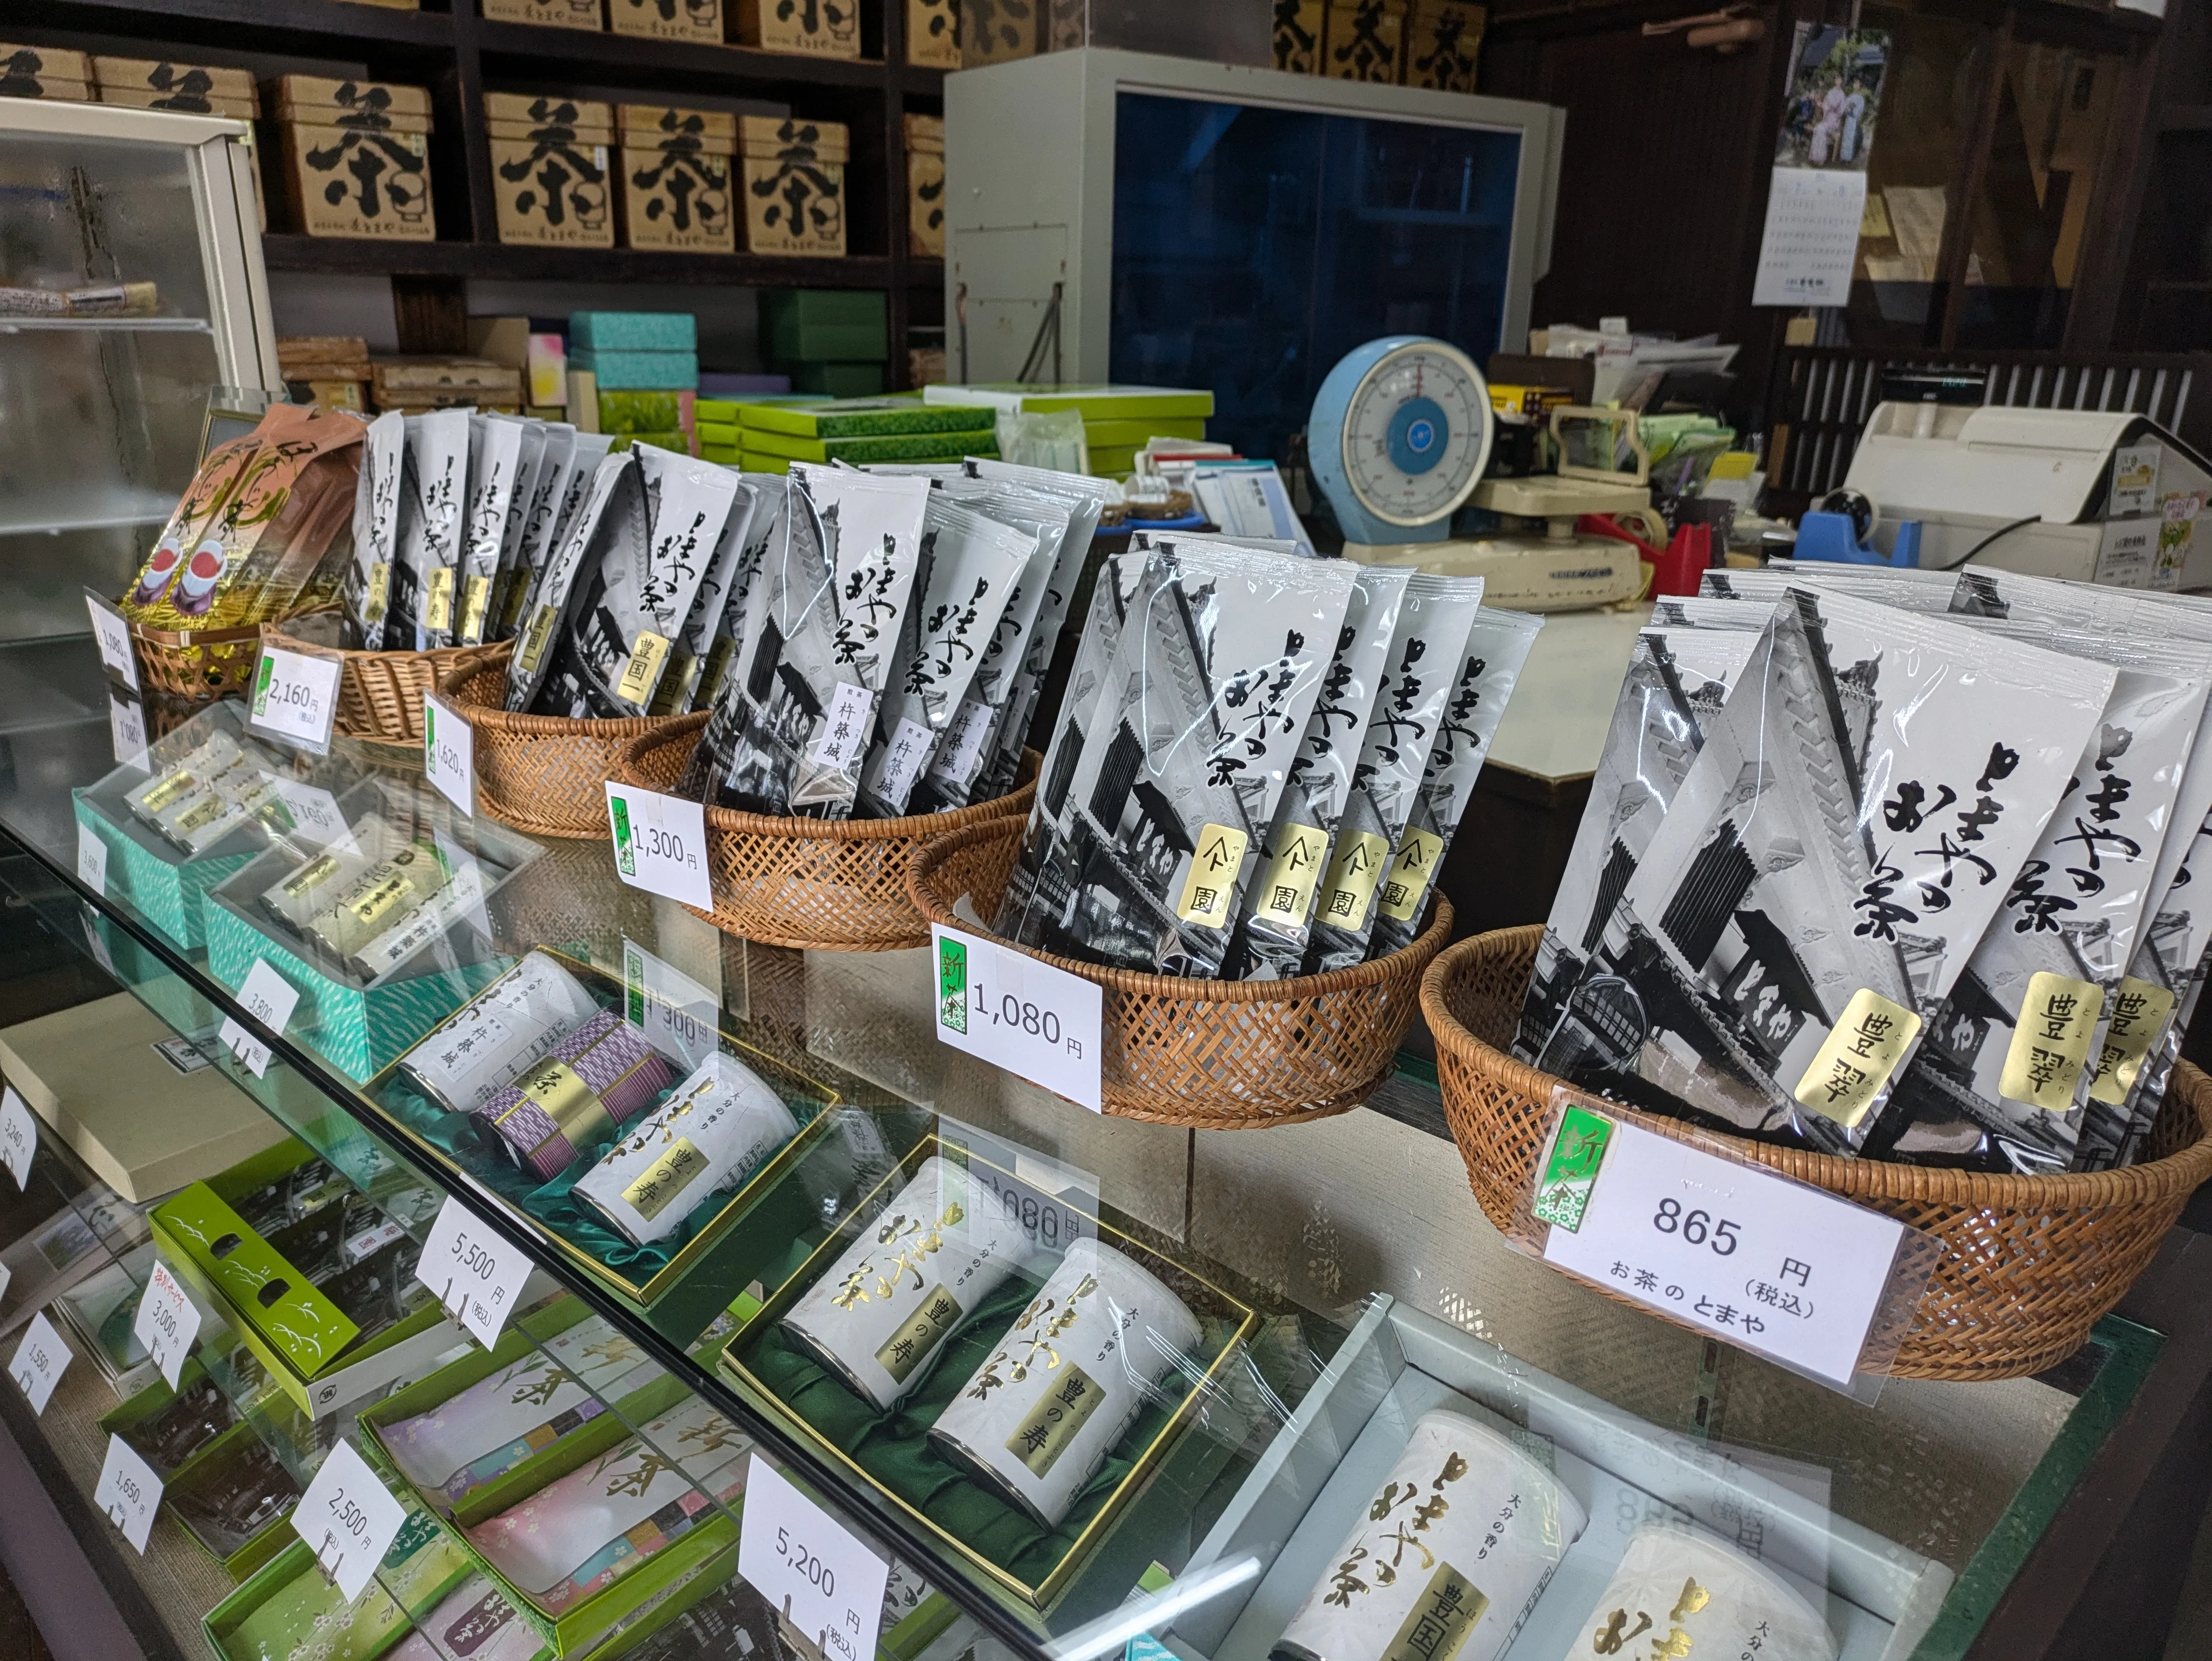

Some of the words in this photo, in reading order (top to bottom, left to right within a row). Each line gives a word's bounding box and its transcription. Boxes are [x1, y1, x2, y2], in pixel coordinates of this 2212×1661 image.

[306, 81, 424, 218] 茶
[499, 98, 605, 226] 茶
[632, 109, 727, 232] 茶
[752, 119, 839, 238] 茶
[103, 629, 123, 657] 1,080
[622, 638, 655, 692] 豊国一
[269, 678, 310, 707] 2,160
[847, 688, 863, 698] 煎茶
[436, 739, 459, 774] 1,620
[823, 701, 855, 762] 杵築城
[907, 727, 923, 739] 煎茶
[940, 714, 971, 774] 杵築城
[877, 739, 912, 799] 杵築城
[1914, 742, 2020, 914] とまやの
[2054, 723, 2142, 898] とまやの
[633, 824, 684, 862] 1,300
[687, 853, 697, 870] 円
[1853, 780, 1957, 942] お茶
[361, 880, 400, 916] とまや
[388, 926, 428, 960] 杵築城
[249, 993, 273, 1023] 3,800
[941, 951, 965, 1019] 新茶
[441, 1027, 488, 1069] 杵築城
[974, 983, 1060, 1044] 1,080
[1067, 1037, 1082, 1060] 円
[2026, 993, 2079, 1095] 豊翠
[1825, 1011, 1893, 1104] 豊翠
[5, 1118, 22, 1148] 3,240
[700, 1092, 741, 1130] 大分の香り
[633, 1149, 693, 1204] 豊の寿
[1557, 1125, 1607, 1210] 新茶
[452, 1232, 495, 1280] 5,500
[491, 1285, 505, 1305] 円
[956, 1240, 998, 1286] 大分の香り
[1652, 1196, 1742, 1257] 865
[1780, 1256, 1812, 1287] 円
[153, 1300, 177, 1338] 3,000
[172, 1337, 179, 1348] 円
[472, 1301, 492, 1327] (税込)
[1745, 1278, 1814, 1320] (税込)
[29, 1343, 48, 1372] 1,550
[889, 1297, 950, 1364] 豊の寿
[1096, 1307, 1140, 1362] 大分の香り
[1019, 1377, 1087, 1455] 豊の寿
[116, 1470, 140, 1503] 1,650
[329, 1487, 367, 1536] 2,500
[361, 1536, 371, 1550] 円
[1477, 1494, 1523, 1560] 大分の香り
[775, 1526, 834, 1597] 5,200
[846, 1608, 860, 1635] 円
[826, 1624, 856, 1661] (税込)
[1391, 1583, 1464, 1661] 豊国
